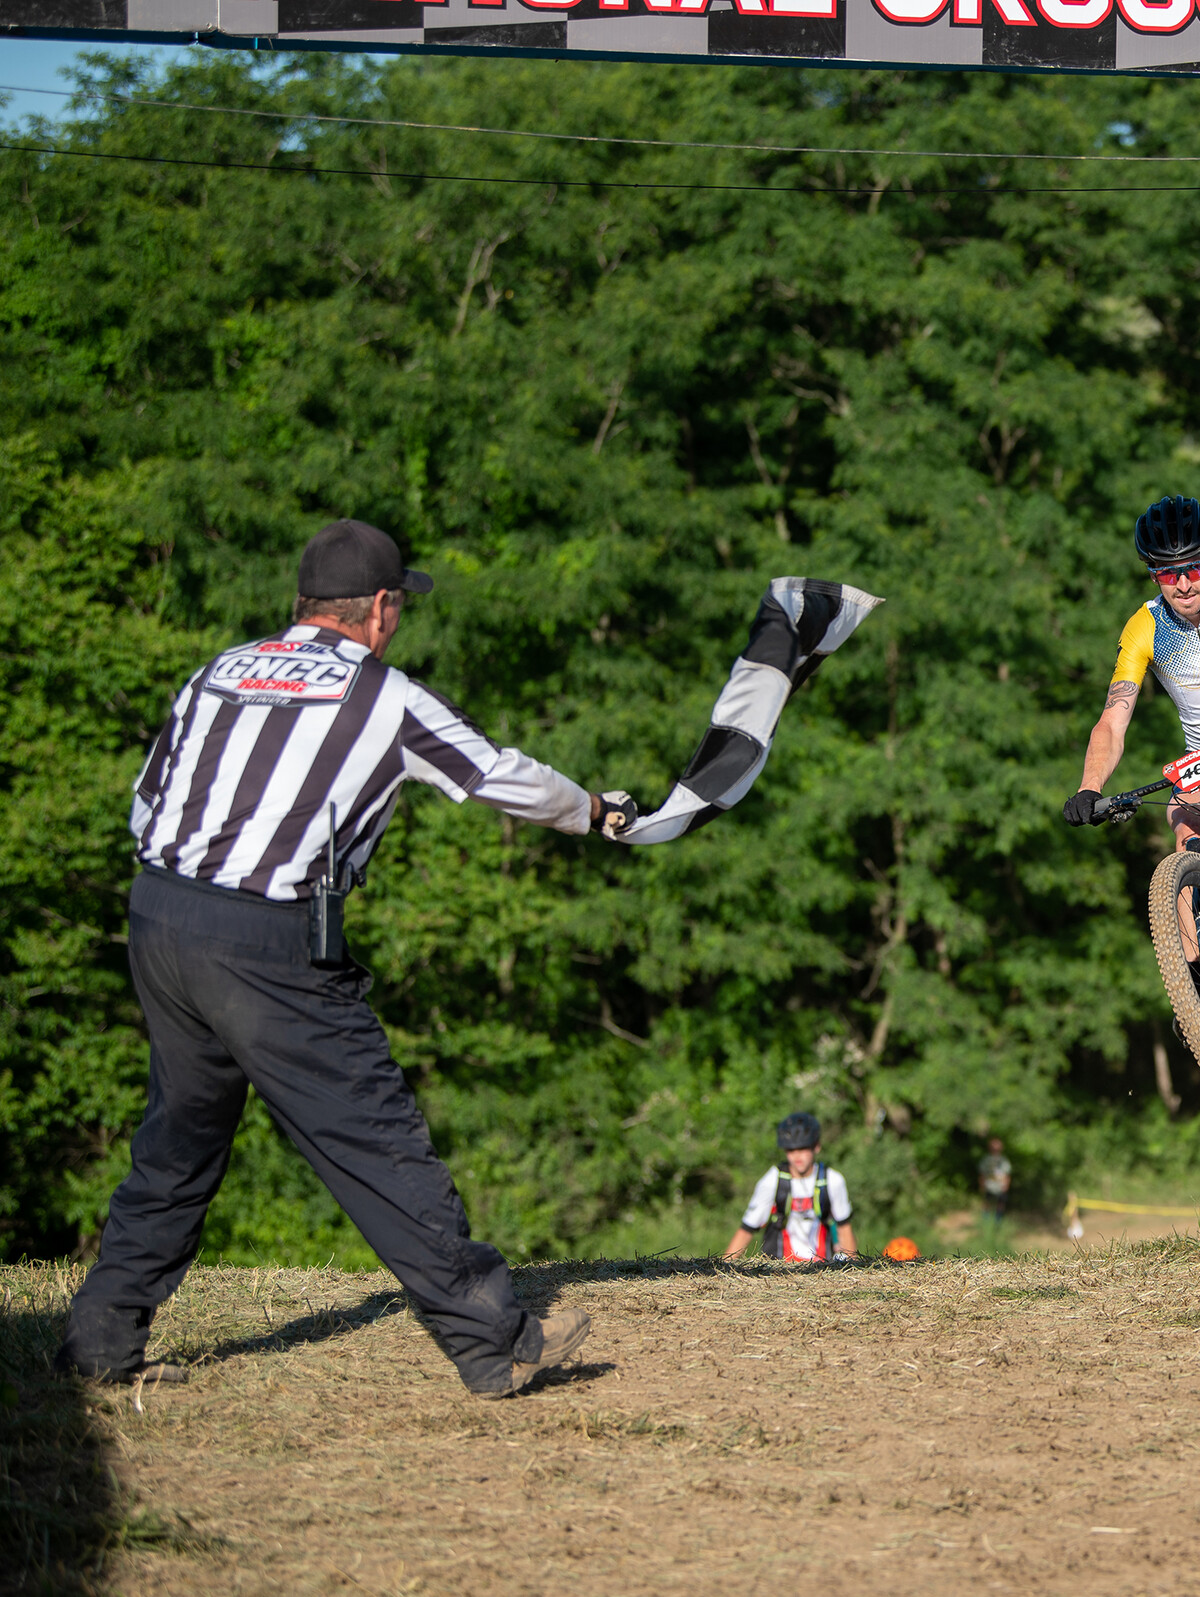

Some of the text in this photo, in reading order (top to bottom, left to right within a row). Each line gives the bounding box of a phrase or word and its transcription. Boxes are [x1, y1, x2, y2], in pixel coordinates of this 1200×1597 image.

[257, 641, 334, 655] AMSOIL
[213, 655, 350, 687] GNCC
[237, 678, 310, 693] RACING
